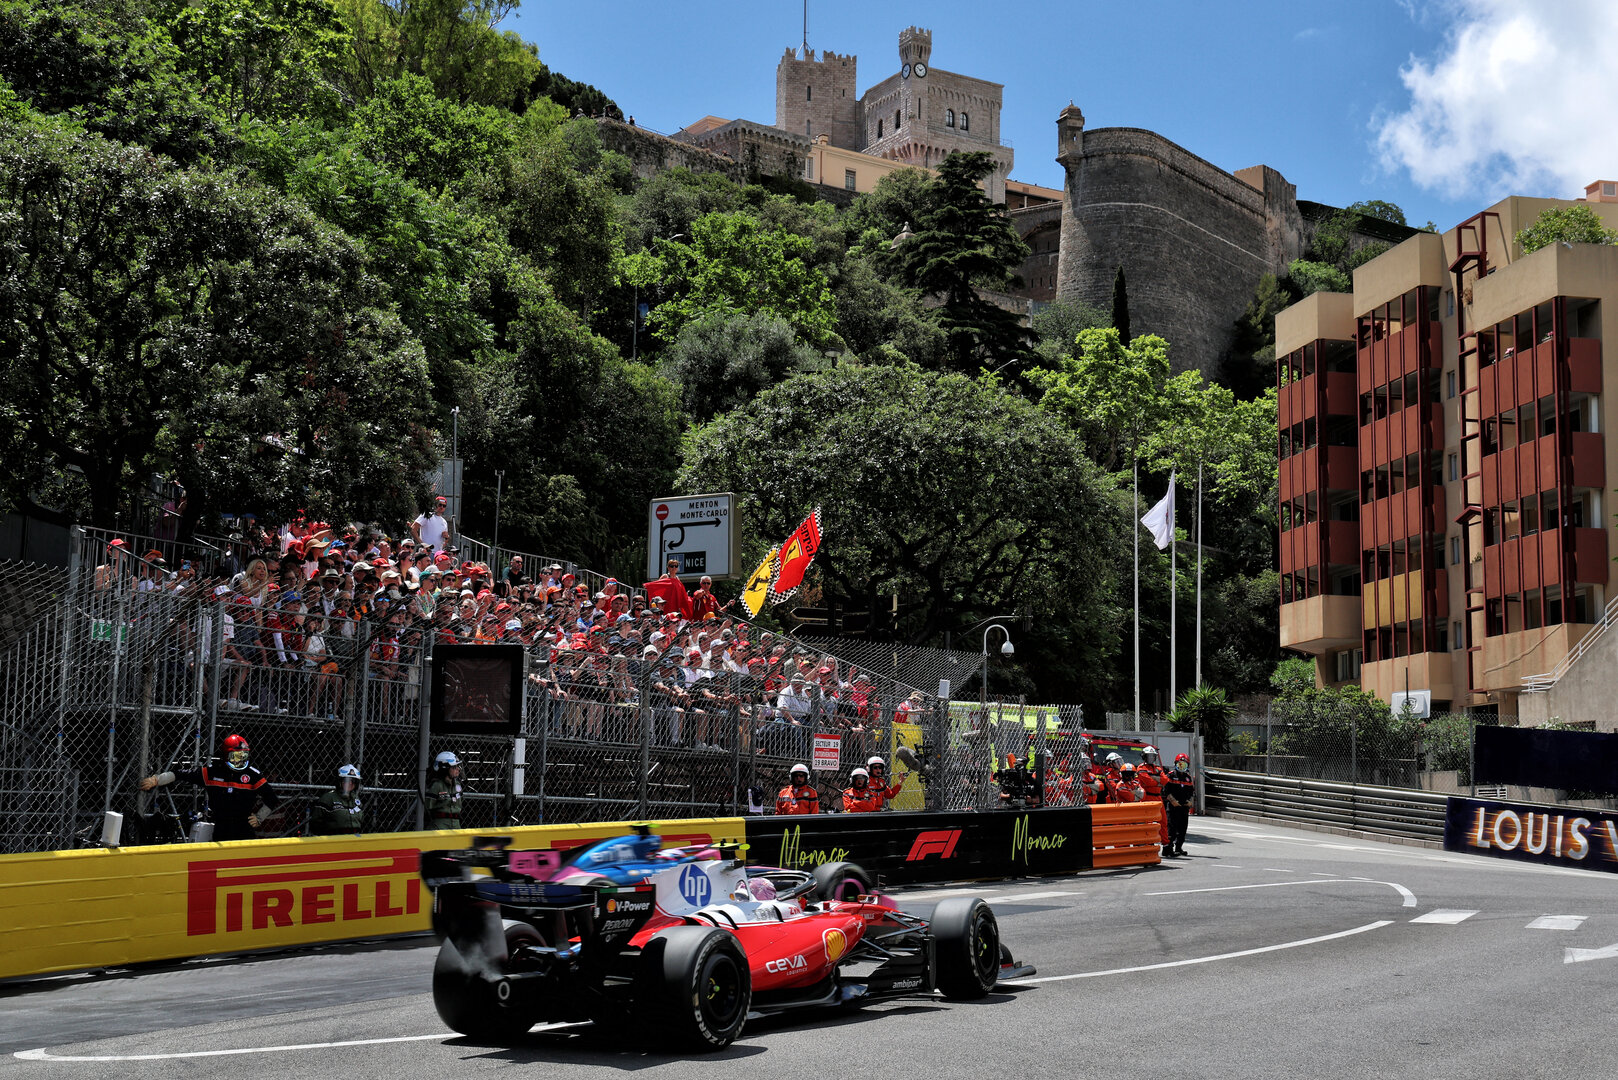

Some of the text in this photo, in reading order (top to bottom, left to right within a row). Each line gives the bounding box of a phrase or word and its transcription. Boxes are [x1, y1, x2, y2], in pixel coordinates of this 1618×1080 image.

[688, 500, 719, 509] MENTON
[680, 508, 728, 519] MONTE-CARLO
[685, 557, 705, 568] NICE
[1011, 814, 1067, 866] Monaco
[1477, 807, 1591, 860] LOUIS
[779, 824, 850, 870] Monaco
[684, 863, 708, 907] hp
[187, 848, 421, 937] PIRELLI
[616, 900, 650, 912] V-Power
[602, 918, 635, 931] PERONI
[786, 967, 808, 976] LOGISTICS
